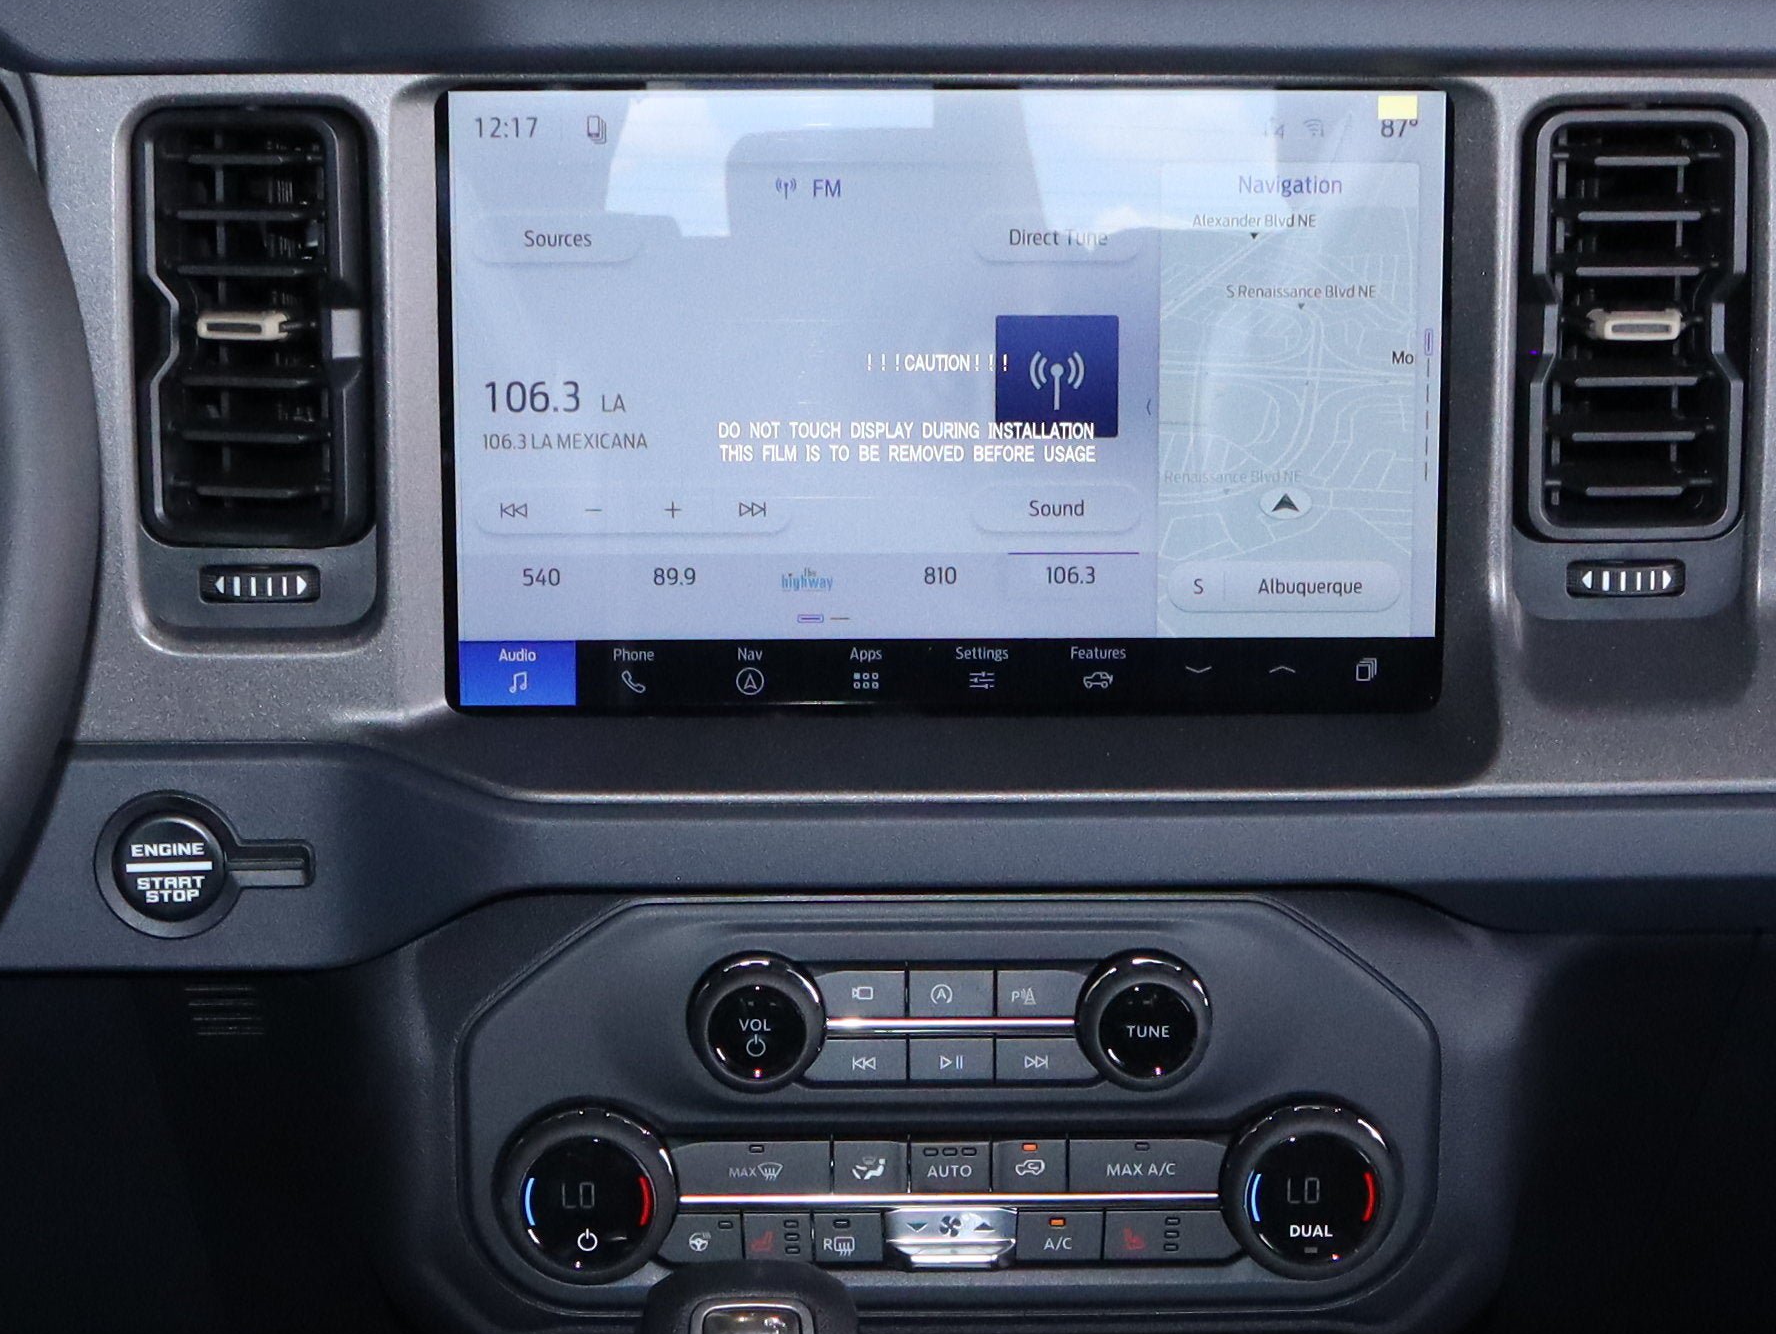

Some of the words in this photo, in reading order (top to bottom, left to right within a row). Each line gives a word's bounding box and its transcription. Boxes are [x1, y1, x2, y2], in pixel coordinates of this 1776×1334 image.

[475, 116, 538, 139] 12:17
[813, 179, 842, 198] FM
[1238, 175, 1342, 198] Navigation
[1192, 214, 1261, 228] Alexander
[1264, 214, 1295, 228] Blvd
[1298, 214, 1317, 228] NE
[524, 229, 592, 248] Sources
[1008, 227, 1052, 247] Direct
[1057, 227, 1108, 247] Tune
[1226, 285, 1235, 300] S
[1237, 285, 1322, 300] Renaissance
[1325, 285, 1355, 300] Blvd
[1358, 285, 1376, 299] NE
[1391, 350, 1414, 365] Mo
[484, 380, 581, 414] 106.3
[601, 393, 626, 413] LA
[718, 421, 741, 440] DO
[749, 421, 780, 440] NOT
[789, 421, 842, 440] TOUCH
[850, 421, 914, 440] DISPLAY
[922, 421, 980, 440] DURING
[988, 421, 1095, 440] INSTALLATION
[483, 433, 527, 450] 106.3
[531, 433, 553, 450] LA
[557, 432, 648, 450] MEXICANA
[719, 444, 754, 463] THIS
[762, 444, 798, 463] FILM
[805, 444, 821, 463] IS
[829, 444, 850, 463] TO
[858, 444, 880, 463] BE
[888, 444, 964, 463] REMOVED
[973, 444, 1035, 463] BEFORE
[1044, 444, 1096, 463] USAGE
[1028, 499, 1085, 518] Sound
[522, 568, 561, 587] 540
[653, 568, 696, 587] 89.9
[781, 573, 834, 592] highway
[923, 566, 958, 586] 810
[1045, 565, 1096, 586] 106.3
[1193, 578, 1204, 595] S
[1258, 578, 1363, 598] Albuquerque
[498, 646, 537, 663] Audio
[612, 646, 655, 662] Phone
[736, 646, 764, 662] Nav
[849, 646, 883, 666] Apps
[954, 645, 1009, 666] Settings
[1069, 645, 1127, 662] Features
[130, 842, 205, 858] ENGINE
[136, 875, 206, 891] START
[145, 889, 200, 904] STOP
[738, 1017, 772, 1033] VOL
[1126, 1024, 1171, 1039] TUNE
[728, 1166, 757, 1179] MAX
[927, 1164, 973, 1179] AUTO
[1106, 1163, 1144, 1177] MAX
[1147, 1162, 1177, 1177] A/C
[1289, 1224, 1334, 1238] DUAL
[1043, 1237, 1073, 1250] A/C
